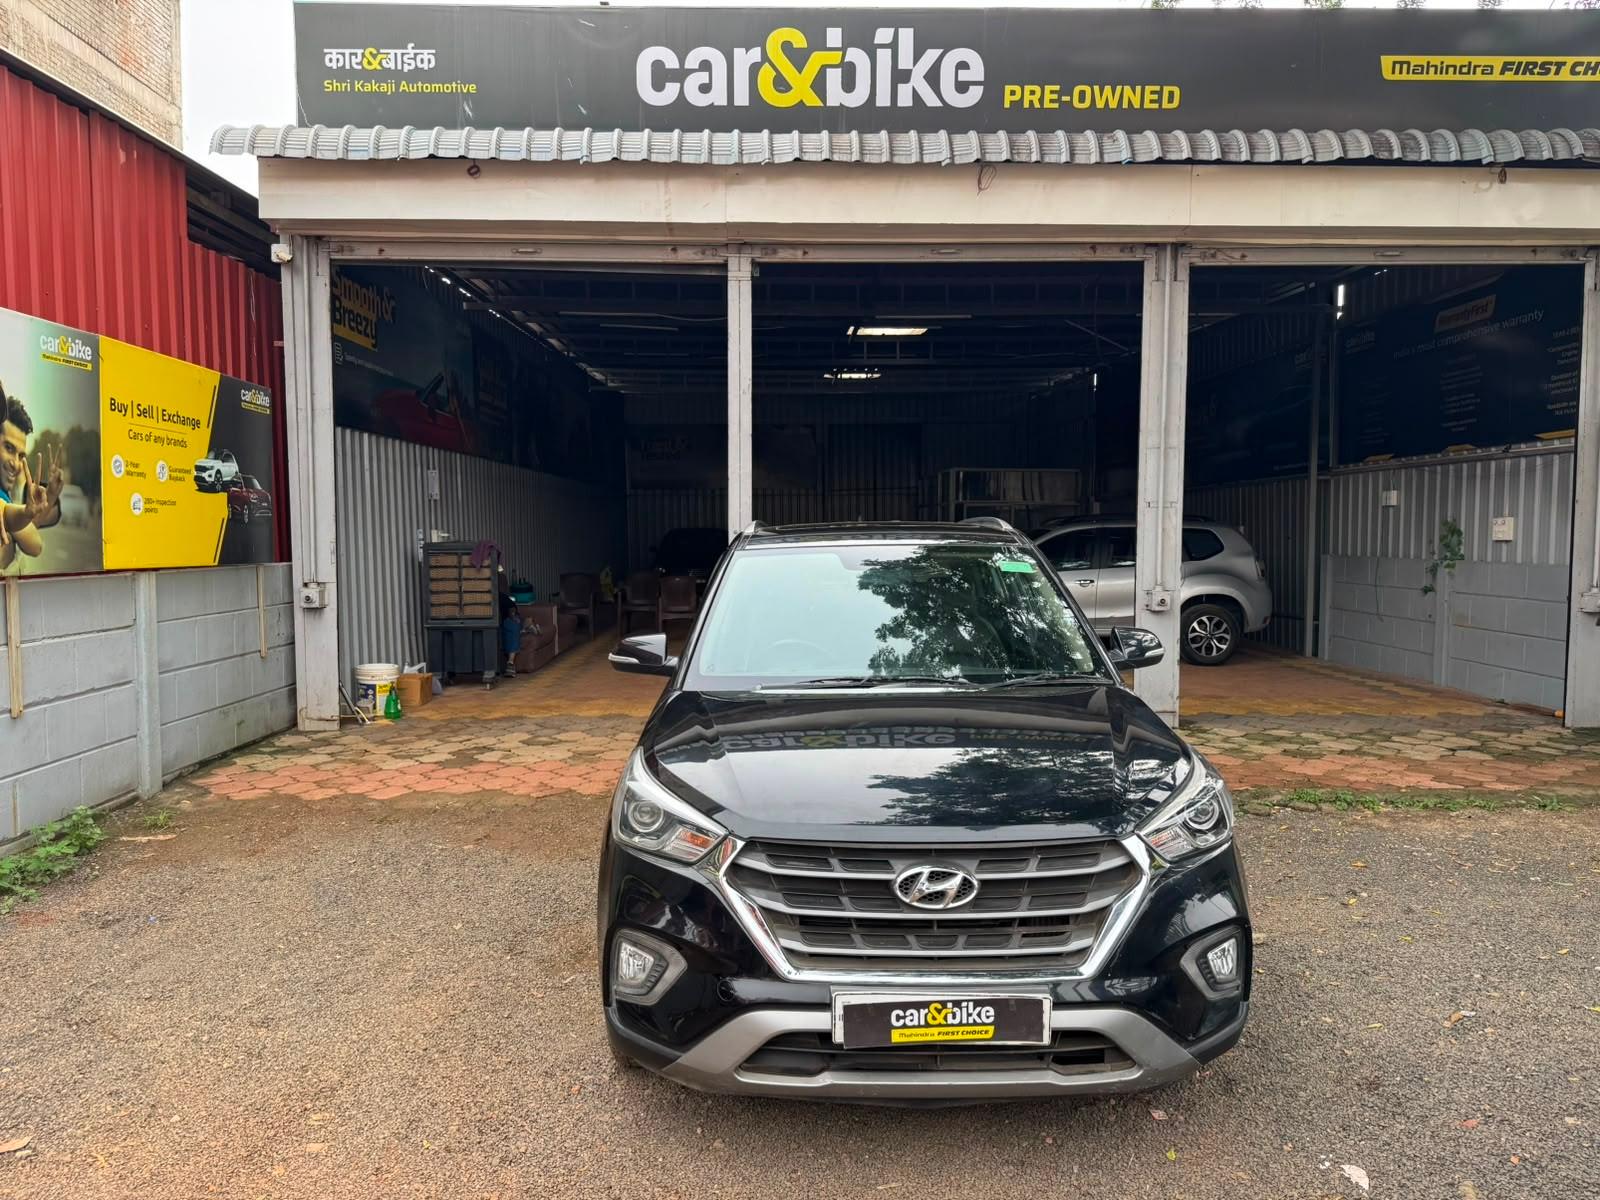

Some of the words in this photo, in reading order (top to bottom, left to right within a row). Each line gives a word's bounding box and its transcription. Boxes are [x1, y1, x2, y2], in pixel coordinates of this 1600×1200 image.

[323, 43, 436, 72] कार&बाईक
[636, 27, 985, 108] car&bike
[1391, 60, 1494, 76] Mahindra
[1499, 61, 1568, 76] FIRST
[1569, 61, 1600, 76] CH
[324, 79, 350, 92] Shri
[354, 79, 396, 95] Kakaji
[399, 80, 478, 93] Automotive
[1003, 85, 1181, 109] PRE-OWNED
[40, 335, 92, 361] car&bike
[109, 397, 129, 417] Buy
[136, 403, 154, 420] Sell
[161, 409, 201, 431] Exchange
[128, 429, 144, 441] Cars
[145, 431, 153, 442] of
[154, 434, 166, 447] any
[166, 435, 188, 448] brands
[891, 1002, 995, 1026] car&bike
